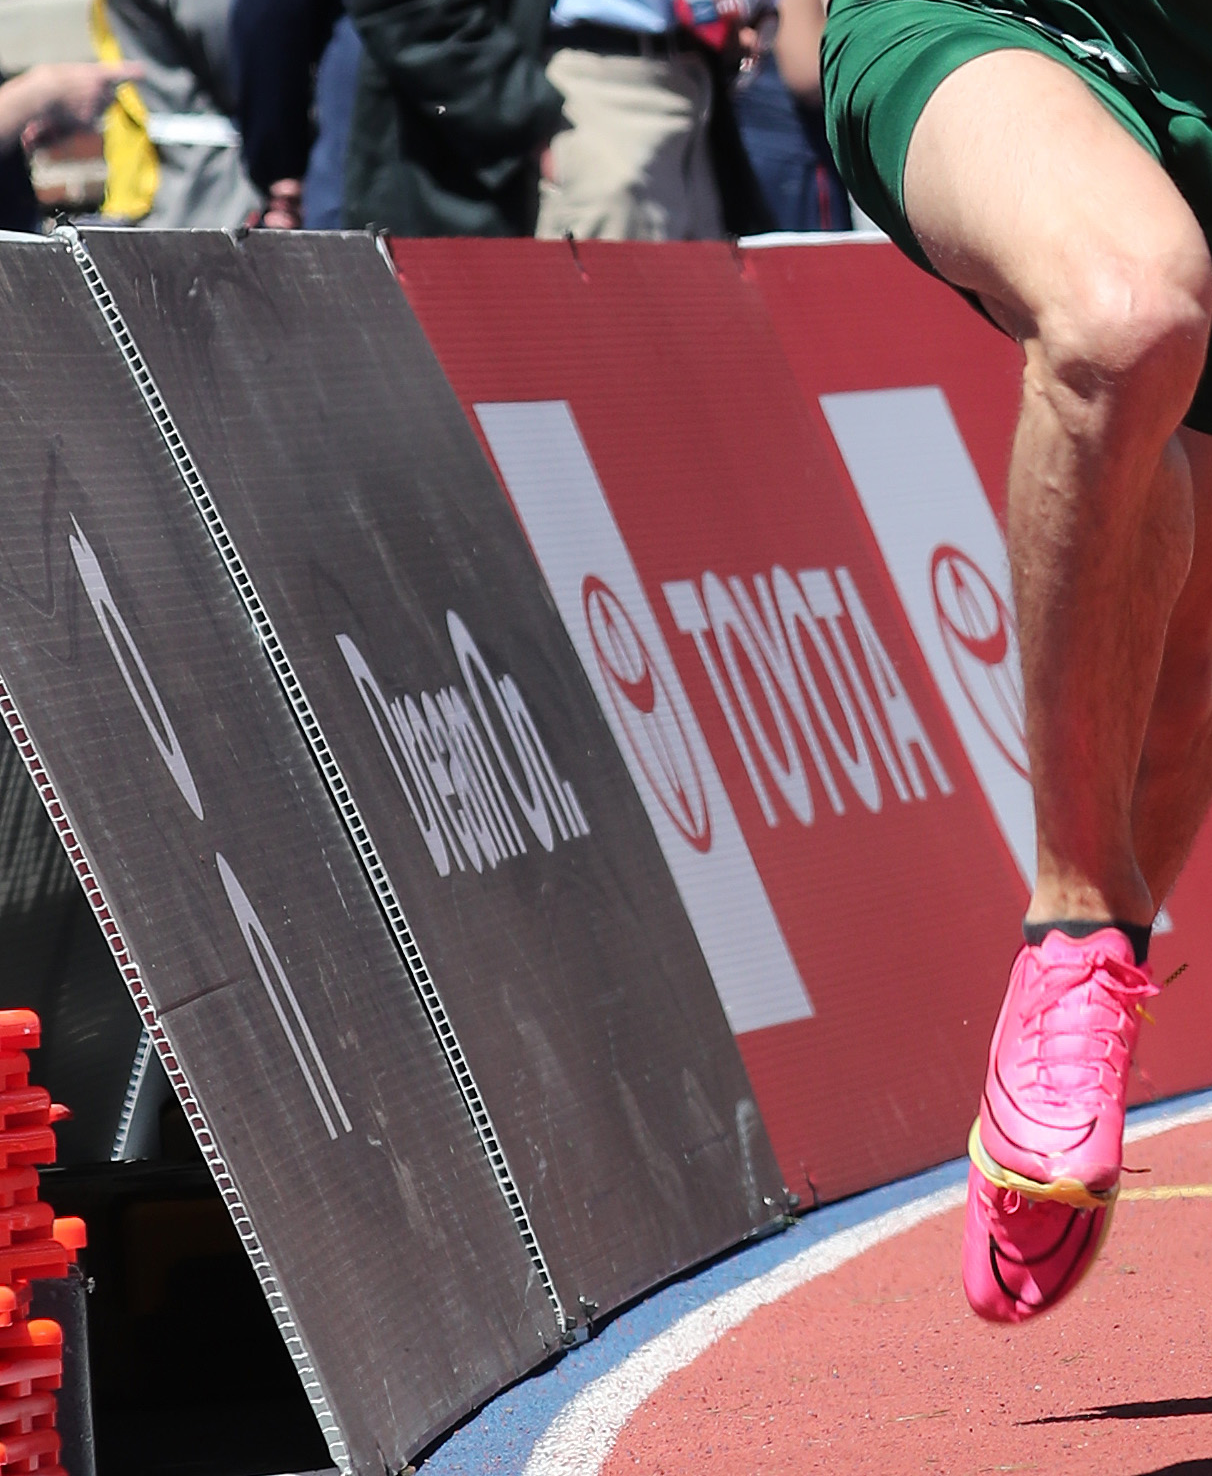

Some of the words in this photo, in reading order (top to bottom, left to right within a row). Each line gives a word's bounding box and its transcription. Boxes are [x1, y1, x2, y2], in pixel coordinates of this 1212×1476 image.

[334, 632, 528, 879] Dream
[446, 607, 591, 854] On.
[661, 564, 955, 829] TOYOTA
